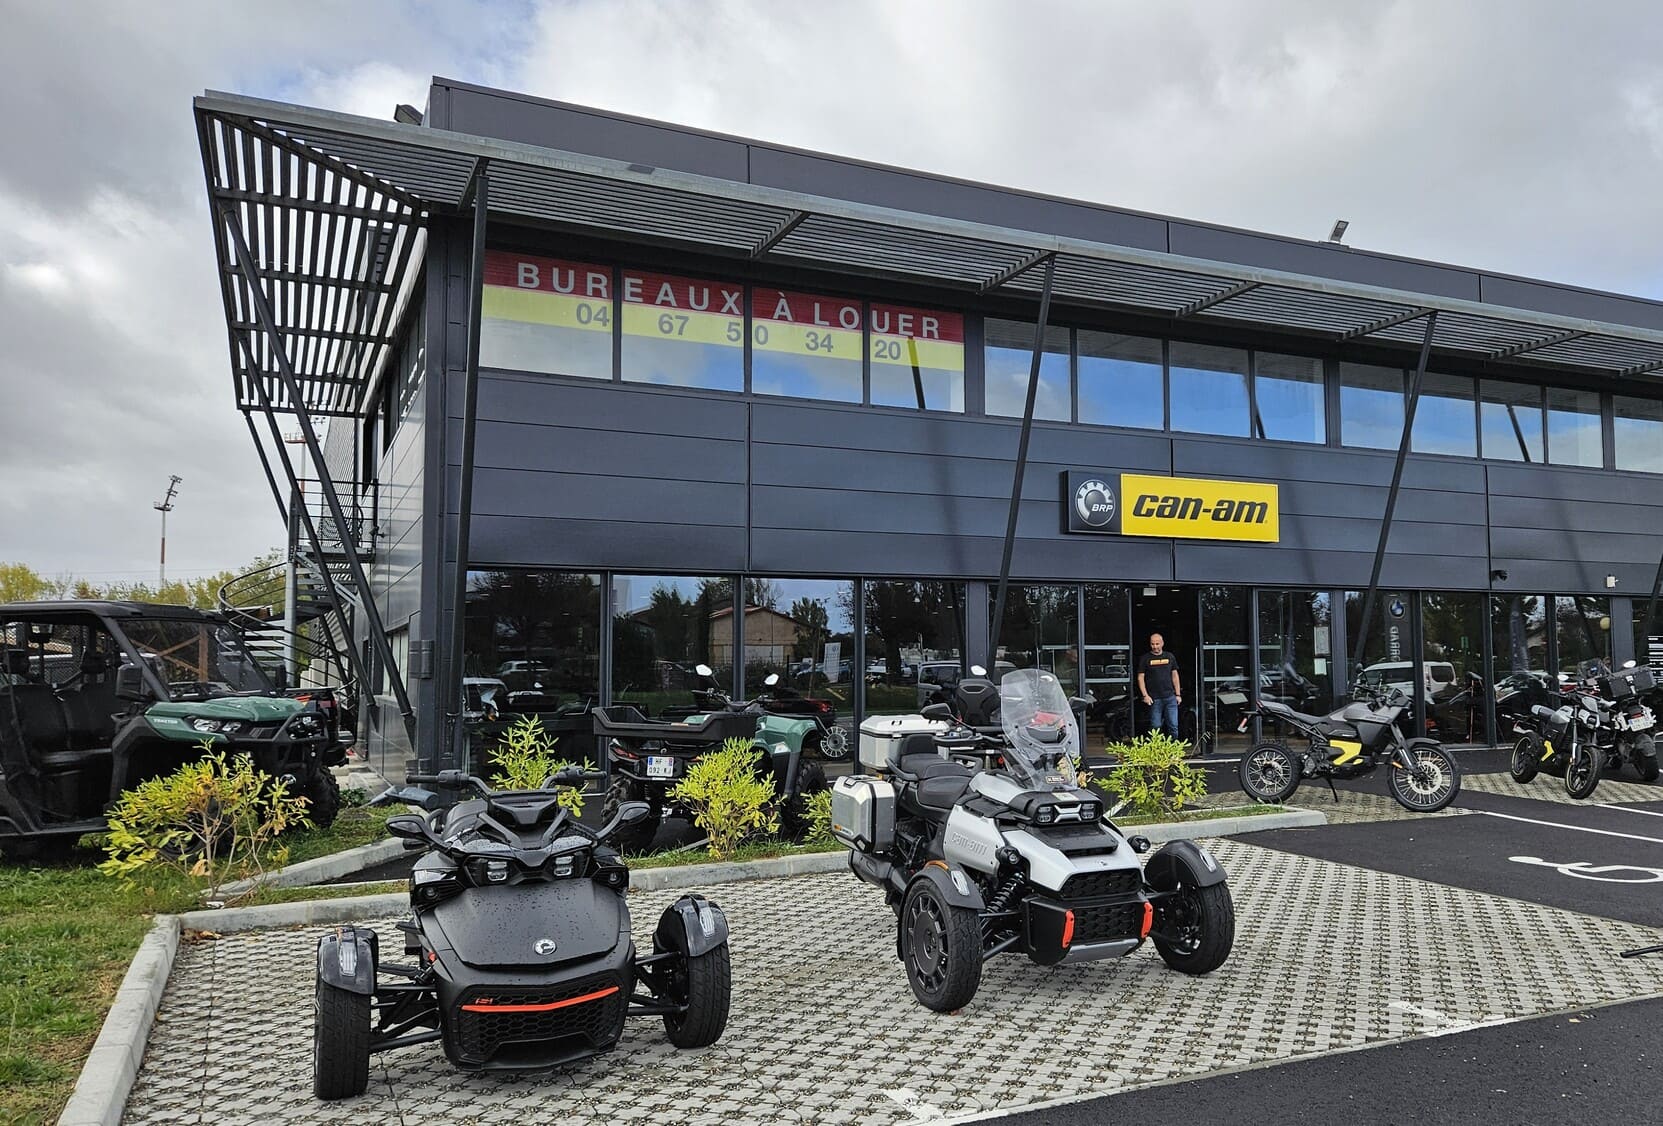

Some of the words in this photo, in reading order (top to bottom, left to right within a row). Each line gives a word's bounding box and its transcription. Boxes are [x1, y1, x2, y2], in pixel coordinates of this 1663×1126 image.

[517, 263, 743, 314] BUREAUX
[773, 292, 794, 321] À
[815, 302, 939, 339] LOUER
[576, 303, 610, 328] 04
[658, 314, 689, 336] 67
[806, 332, 834, 353] 34
[875, 340, 901, 360] 20
[1092, 504, 1113, 512] BRP
[1133, 494, 1267, 523] can-am
